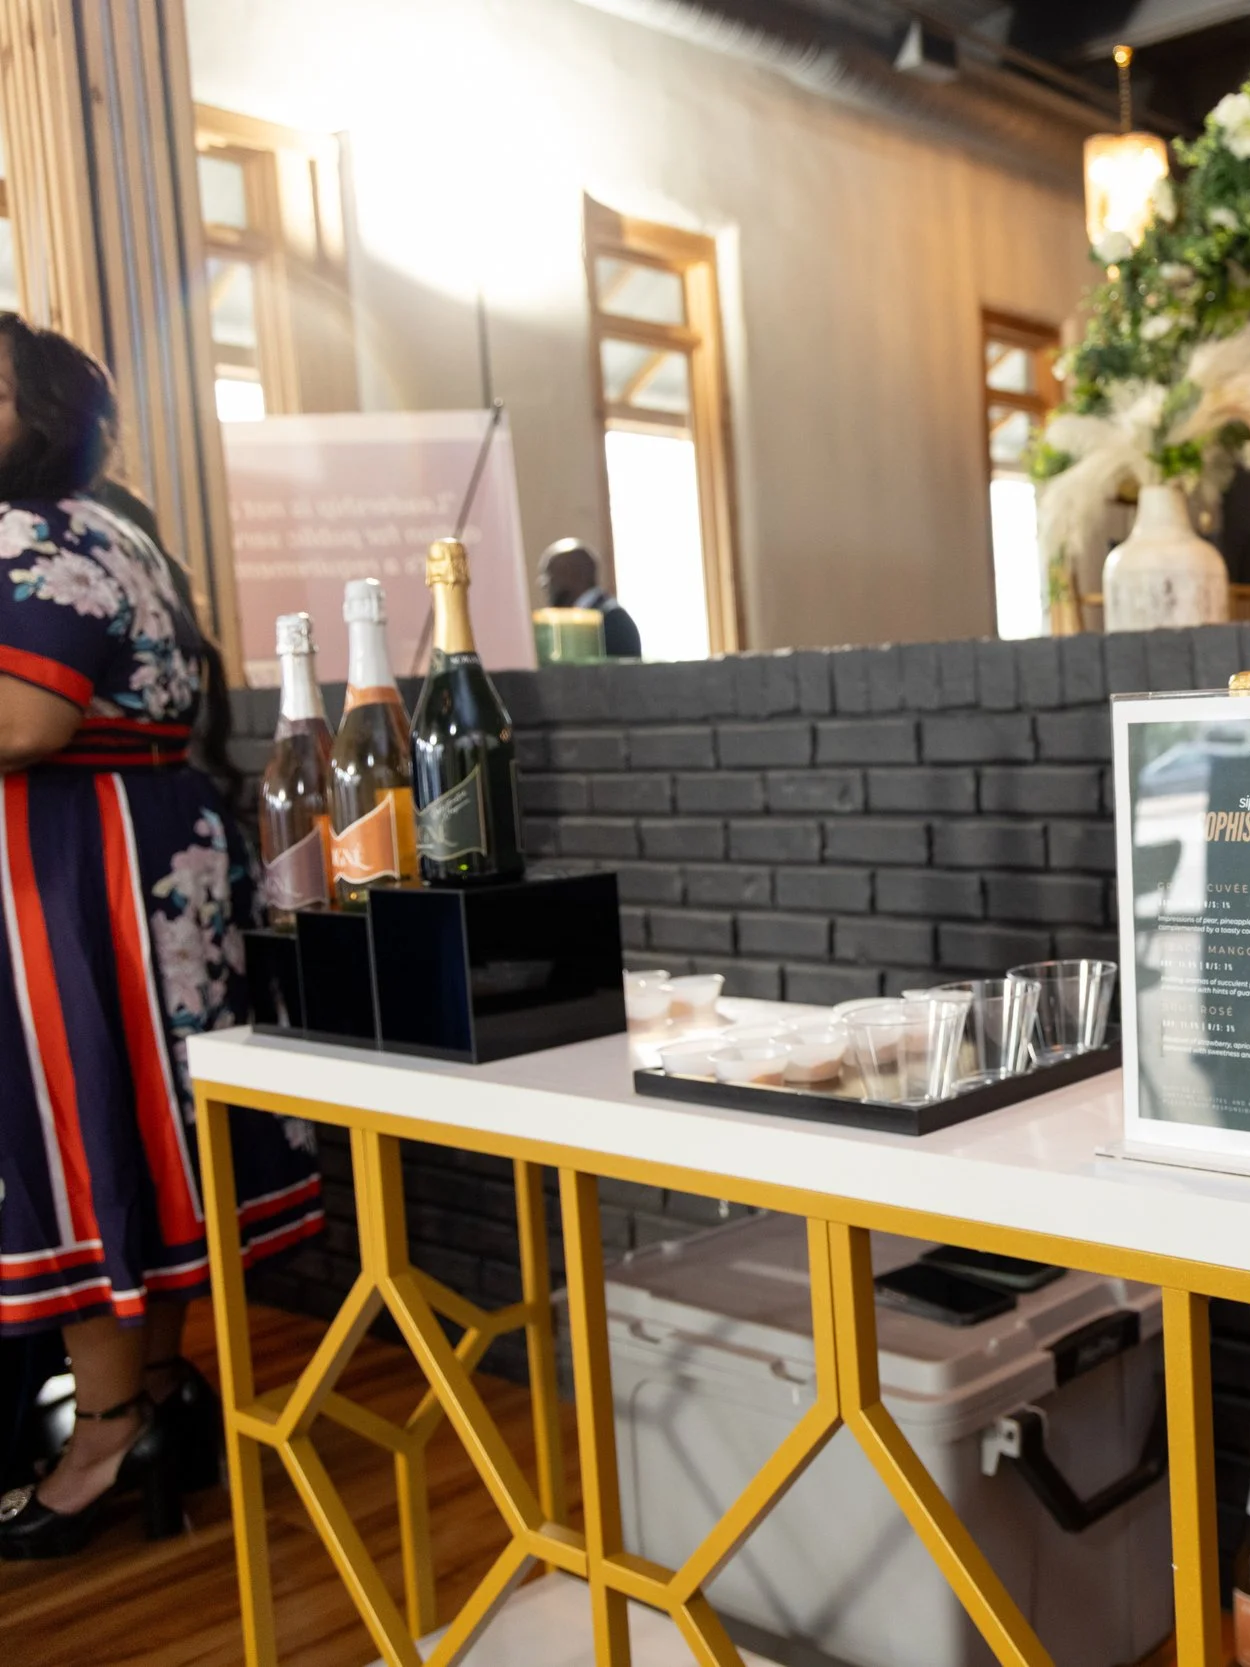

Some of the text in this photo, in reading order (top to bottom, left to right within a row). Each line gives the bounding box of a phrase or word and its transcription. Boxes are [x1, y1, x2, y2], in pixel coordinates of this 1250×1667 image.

[1203, 917, 1219, 925] pear,
[1206, 926, 1215, 934] by
[1220, 926, 1240, 935] toasty
[1218, 979, 1248, 988] succulent
[1213, 987, 1229, 995] hints
[1207, 1047, 1240, 1057] sweetness
